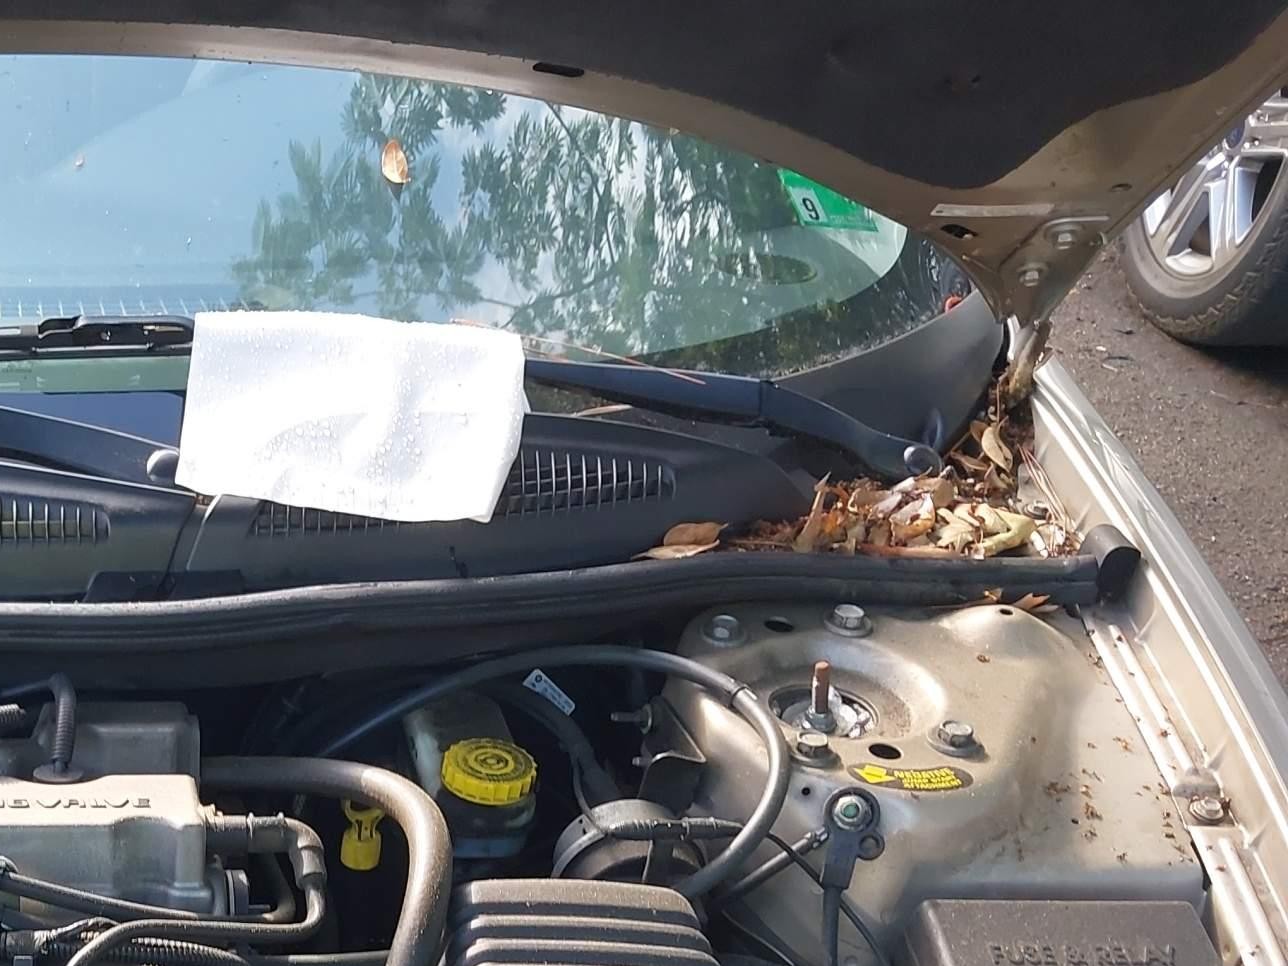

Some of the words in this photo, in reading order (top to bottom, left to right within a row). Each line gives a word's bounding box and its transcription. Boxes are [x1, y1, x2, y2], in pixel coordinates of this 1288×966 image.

[801, 197, 820, 221] 9
[989, 944, 1058, 966] FUSE
[1065, 944, 1090, 966] &
